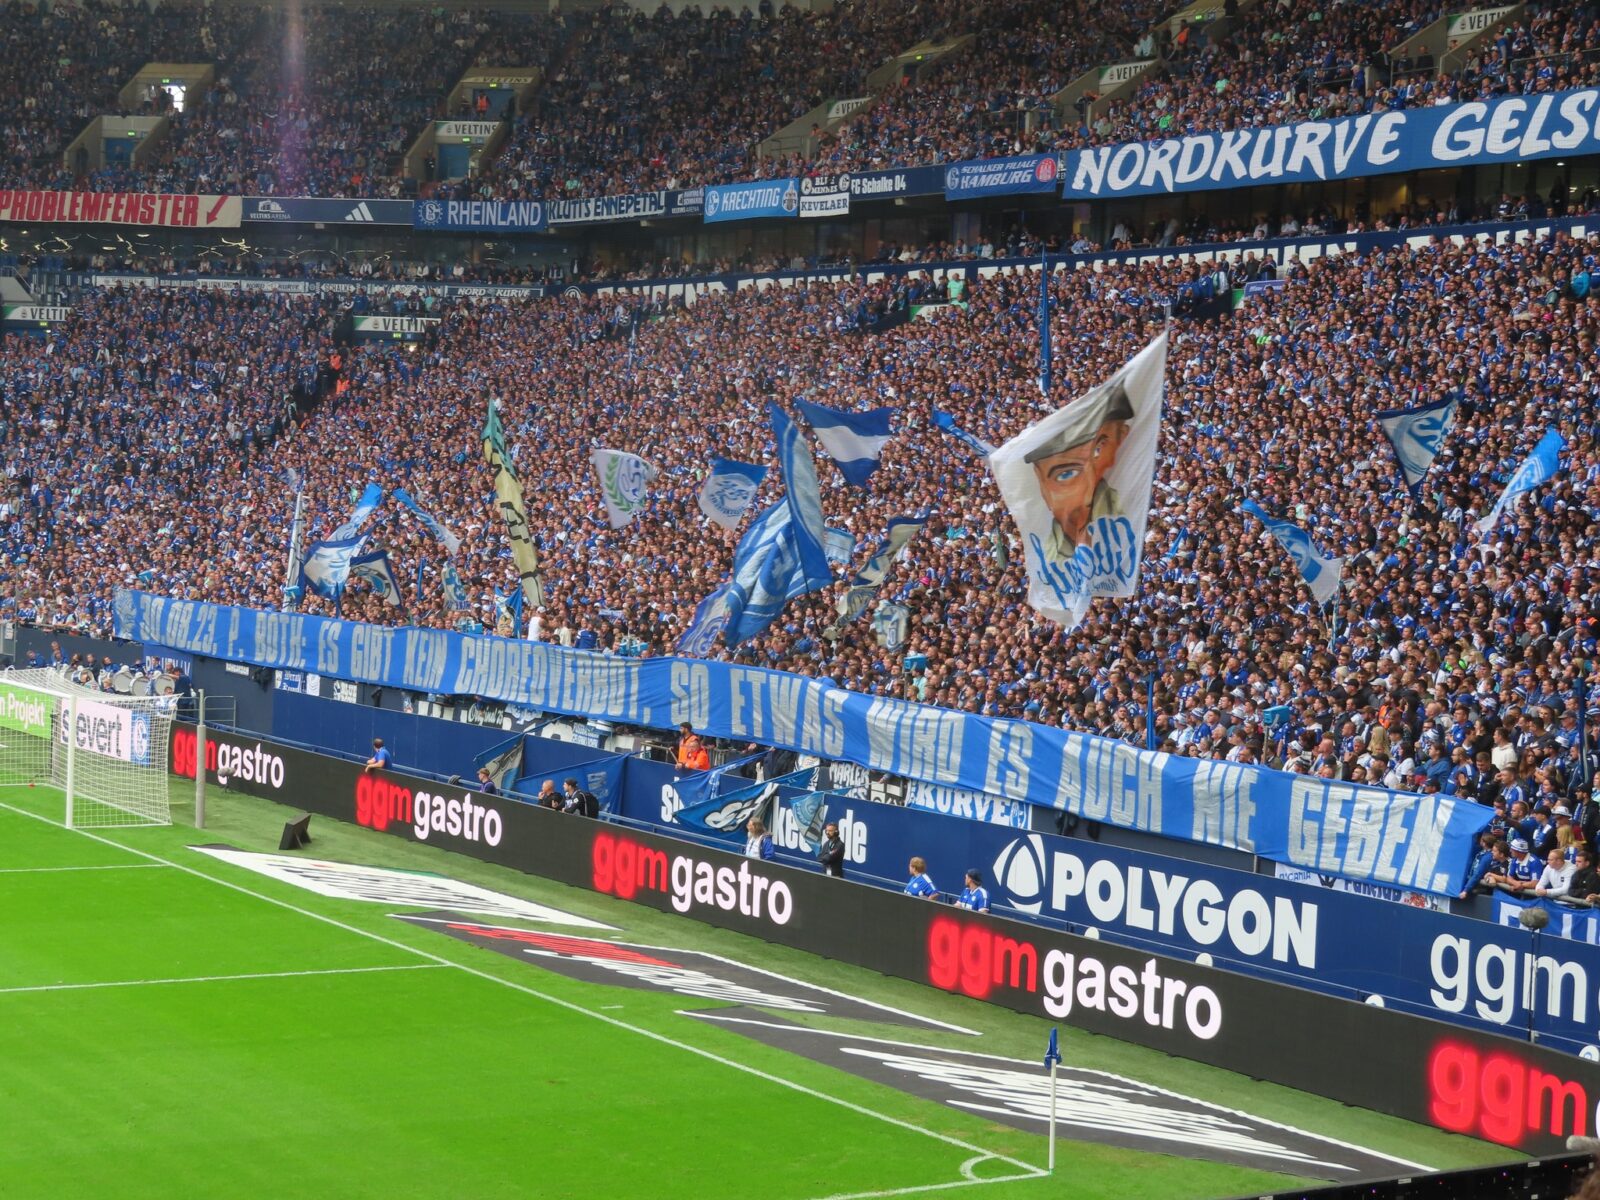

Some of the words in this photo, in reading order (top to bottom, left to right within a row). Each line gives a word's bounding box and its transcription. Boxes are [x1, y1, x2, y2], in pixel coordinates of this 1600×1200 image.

[1071, 109, 1407, 195] NORDKURVE
[1431, 89, 1600, 161] GELS
[851, 180, 861, 194] FC
[862, 177, 893, 194] Schalke
[895, 174, 906, 191] 04
[960, 170, 1033, 189] HAMBURG
[961, 163, 1006, 174] SCHALKER
[1007, 159, 1037, 171] FILIALE
[0, 190, 199, 226] PROBLEMFENSTER
[448, 202, 541, 226] RHEINLAND
[594, 192, 664, 216] ENNEPETAL
[721, 187, 780, 212] KRECHTING
[801, 198, 848, 211] KEVELAER
[458, 287, 486, 297] NORD
[31, 308, 69, 320] VELTIN
[383, 318, 427, 331] VELTIN
[8, 694, 46, 728] Projekt
[61, 708, 122, 757] severt
[217, 743, 284, 789] gastro
[317, 621, 341, 673] ES
[352, 624, 394, 682] GIBT
[403, 630, 448, 689] KEIN
[670, 661, 708, 729] SO
[730, 668, 849, 757] ETWAS
[866, 698, 965, 783] WIRD
[984, 720, 1033, 801] ES
[1053, 734, 1169, 833] AUCH
[1192, 761, 1259, 852] NIE
[1287, 776, 1455, 891] GEBEN.
[356, 774, 411, 831] ggm
[414, 793, 502, 847] gastro
[916, 781, 1012, 824] KURVE
[593, 834, 668, 899] ggm
[671, 856, 792, 925] gastro
[1052, 852, 1318, 968] POLYGON
[928, 918, 1037, 997] ggm
[1043, 949, 1222, 1039] gastro
[1430, 933, 1587, 1025] ggm
[1432, 1044, 1586, 1143] ggm
